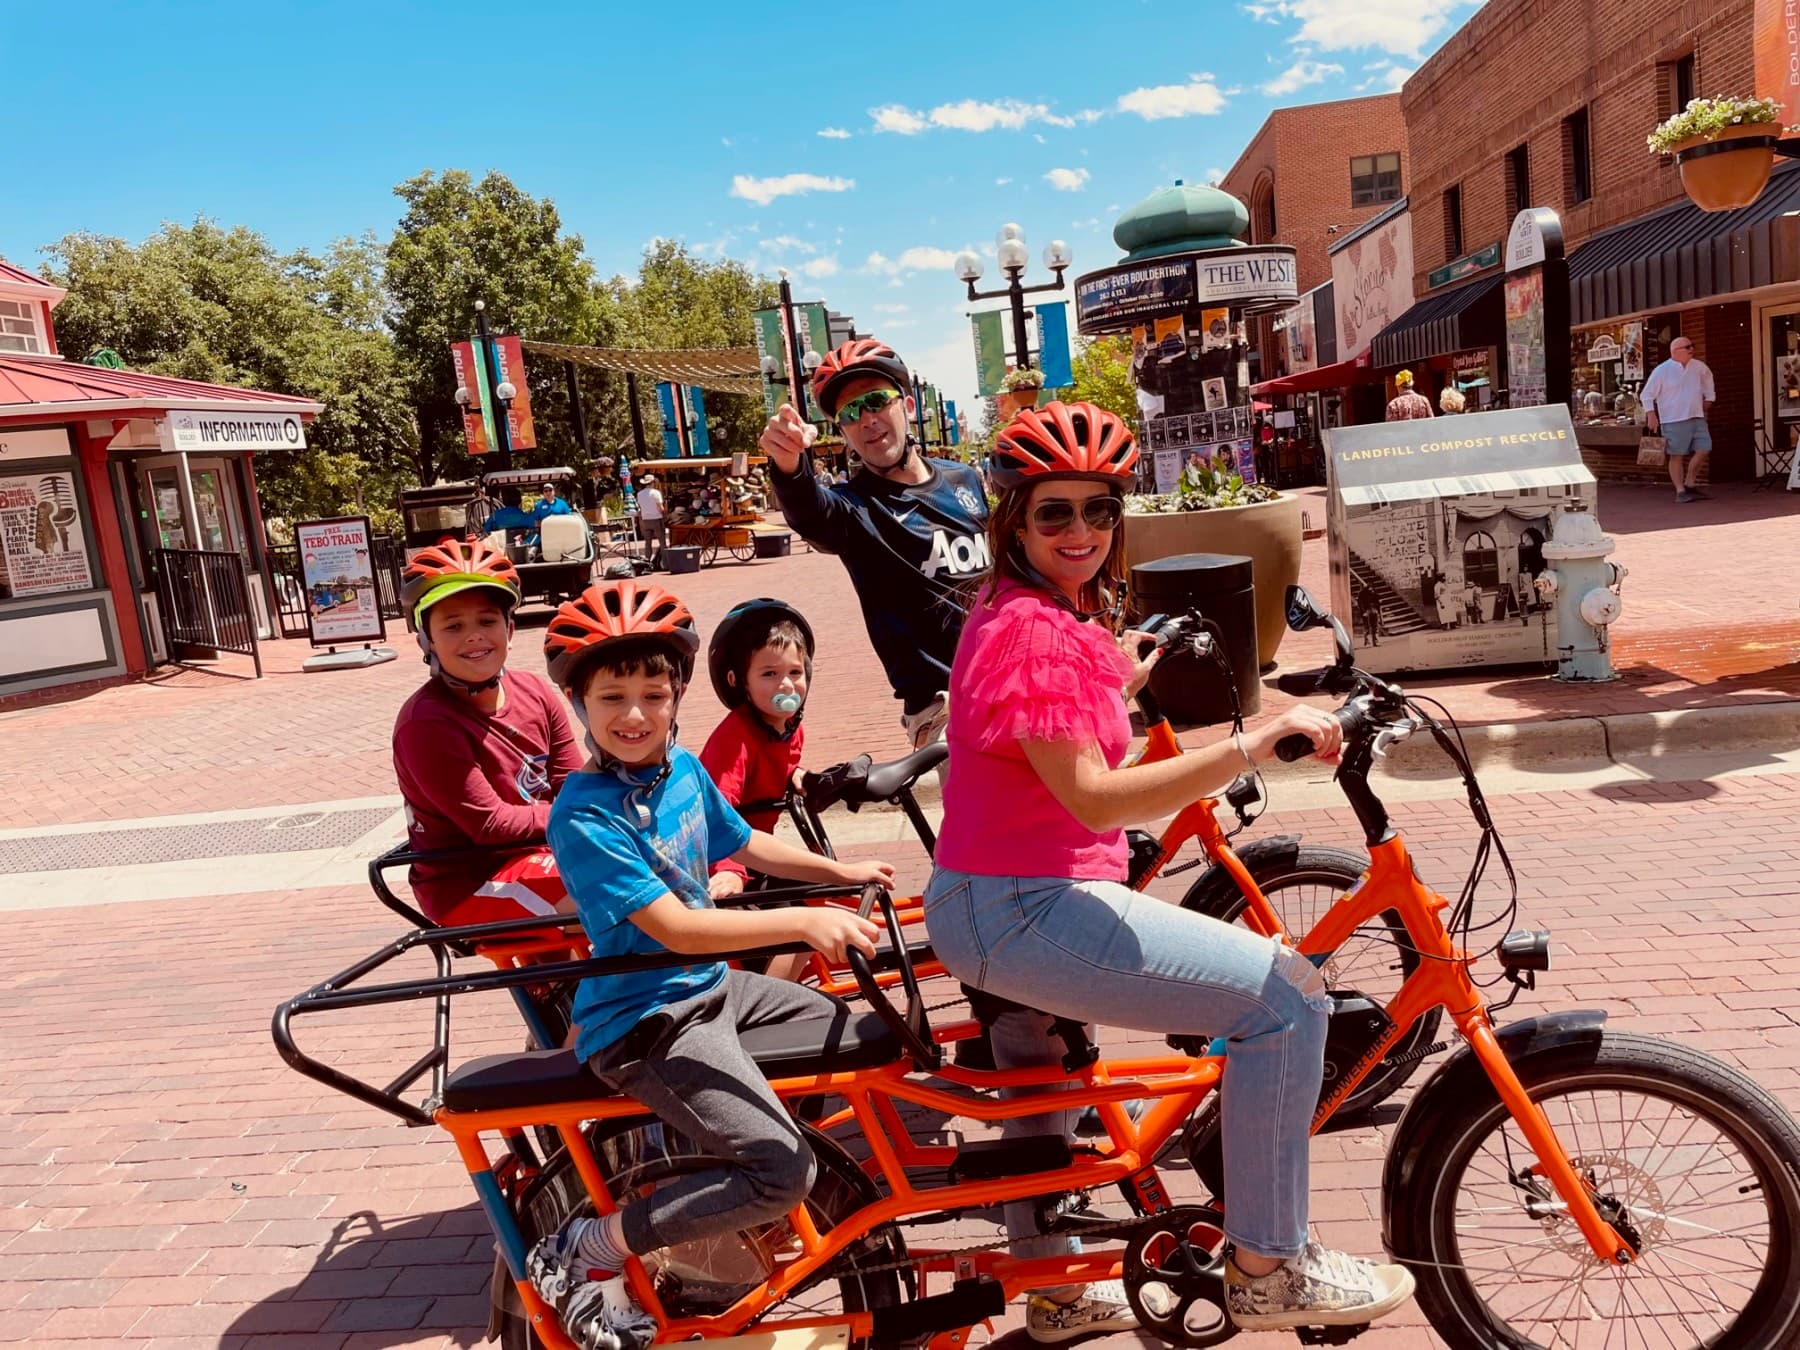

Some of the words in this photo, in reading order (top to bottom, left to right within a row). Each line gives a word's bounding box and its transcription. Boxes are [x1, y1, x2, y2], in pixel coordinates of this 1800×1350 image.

[1785, 0, 1800, 86] BOLDER
[1130, 266, 1187, 283] BOULDERTHON
[1205, 265, 1245, 284] THE
[1136, 303, 1170, 312] INAUGURAL
[755, 318, 774, 414] BOLDEULDER
[453, 349, 475, 444] BOLDELDER
[497, 344, 520, 439] BOLDELDER
[199, 421, 283, 441] INFORMATION
[1342, 446, 1414, 462] LANDFILL
[1420, 437, 1493, 454] COMPOST
[1500, 430, 1566, 446] RECYCLE
[12, 527, 27, 536] PM
[323, 526, 342, 535] FREE
[304, 536, 330, 549] TEBO
[331, 533, 363, 545] TRAIN
[9, 547, 30, 556] MALL
[920, 530, 990, 578] AON
[1326, 1060, 1365, 1106] POWER
[1365, 1022, 1398, 1060] BIKES
